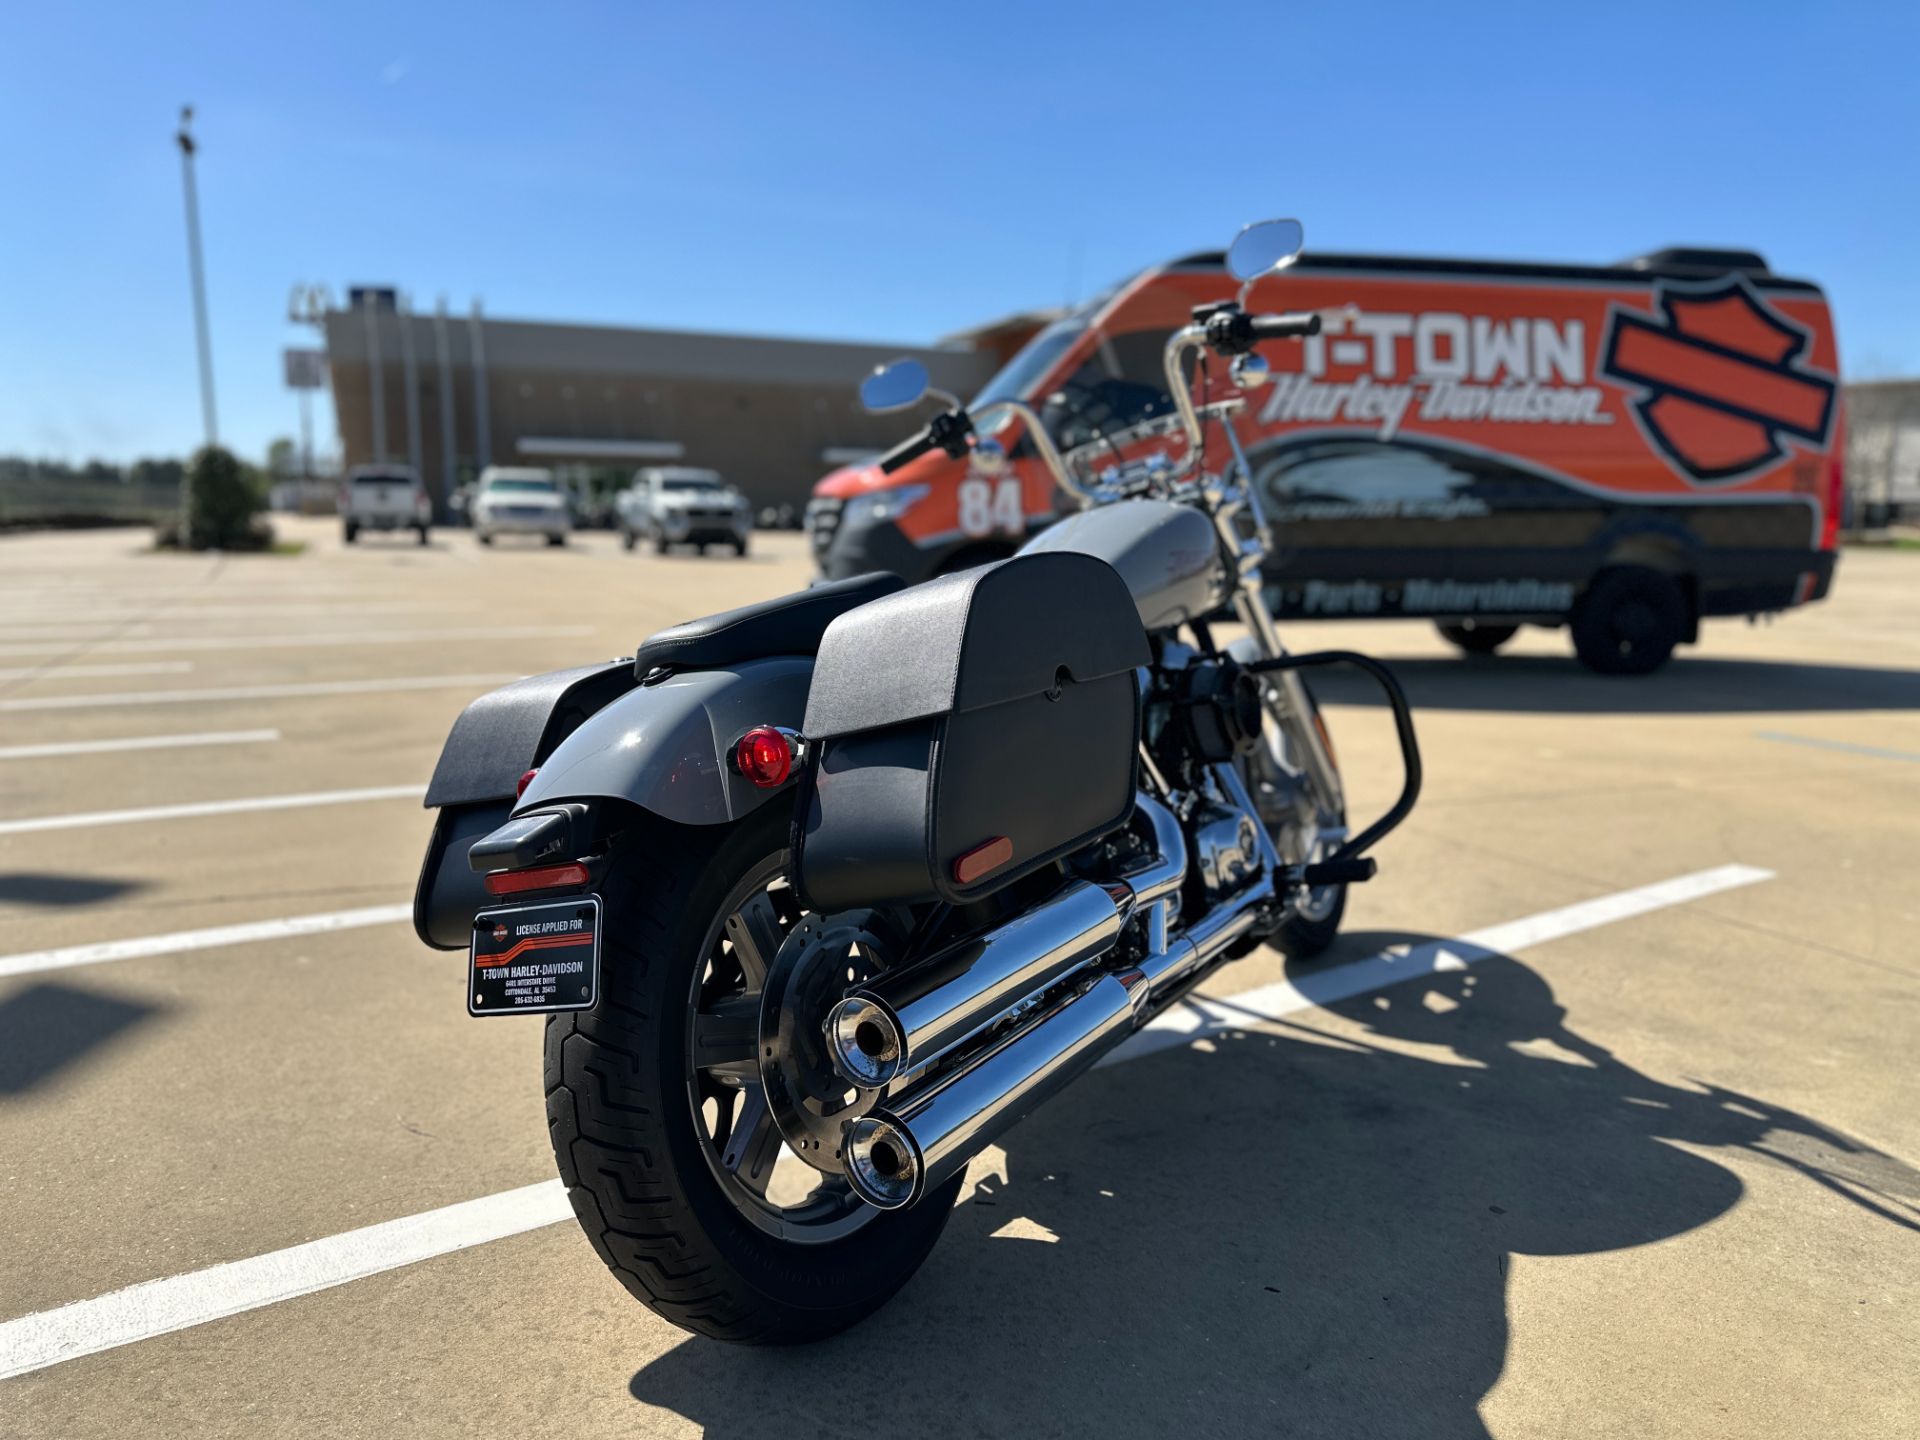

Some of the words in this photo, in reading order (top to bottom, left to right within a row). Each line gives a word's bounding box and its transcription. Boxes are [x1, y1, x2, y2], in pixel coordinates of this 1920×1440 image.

[1290, 312, 1585, 383] T-TOWN
[959, 479, 1023, 536] 84
[516, 923, 541, 936] LICENSE
[541, 921, 568, 934] APPLIED
[570, 919, 583, 930] FOR
[483, 968, 509, 979] T-TOWN
[511, 961, 583, 977] HARLEY-DAVIDSON
